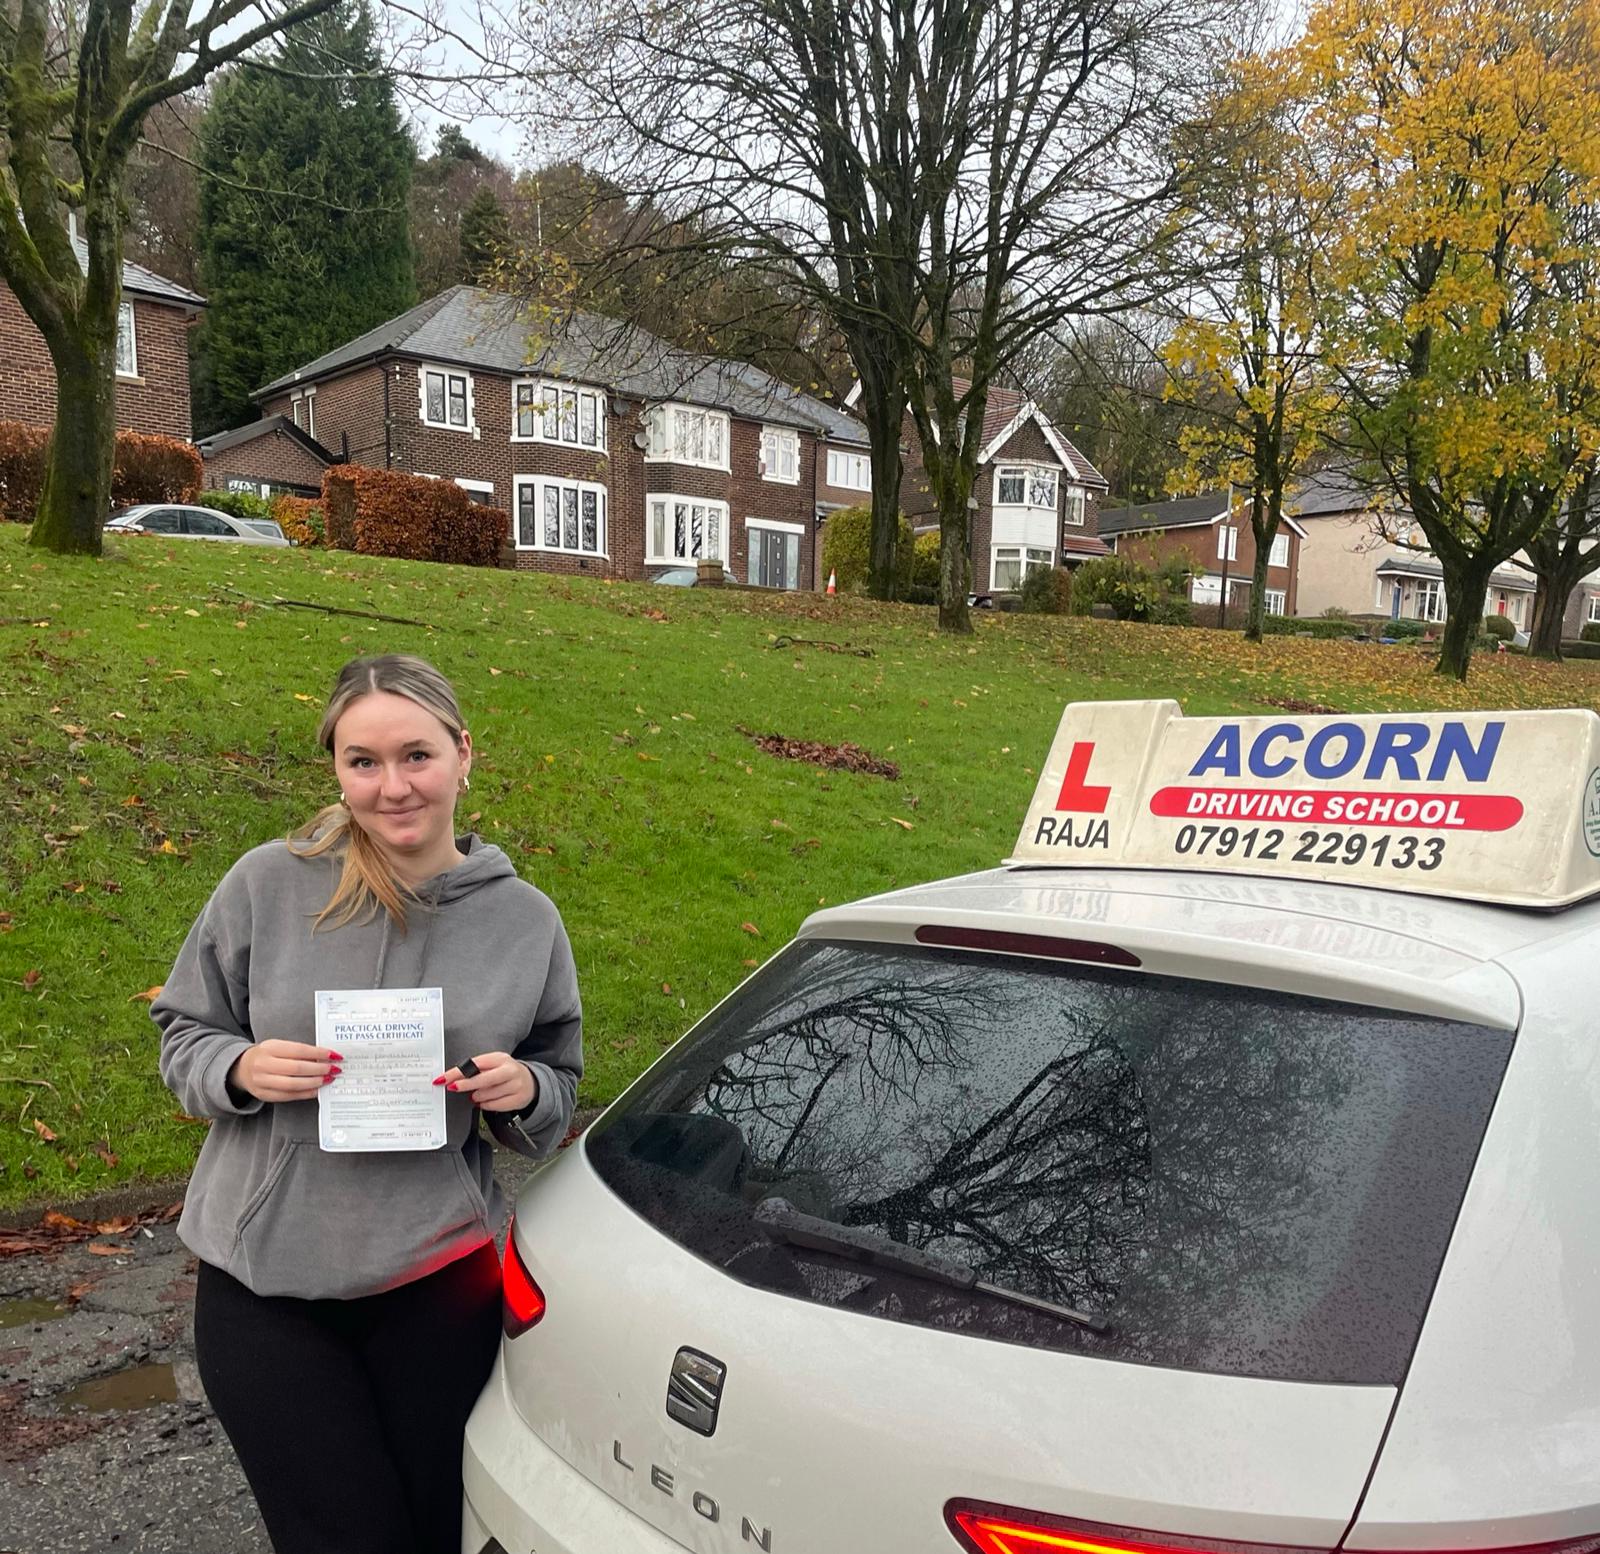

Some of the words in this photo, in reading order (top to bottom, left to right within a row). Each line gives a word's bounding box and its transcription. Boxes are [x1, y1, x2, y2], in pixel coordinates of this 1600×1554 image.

[1189, 722, 1505, 782] ACORN
[1055, 742, 1111, 813] L
[1186, 792, 1314, 818] DRIVING
[1323, 796, 1465, 825] SCHOOL
[1034, 817, 1109, 849] RAJA
[1175, 824, 1284, 860] 07912
[1291, 831, 1445, 871] 229133
[335, 1024, 382, 1033] PRACTICAL
[385, 1023, 424, 1032] DRIVING
[355, 1032, 374, 1040] PASS
[613, 1439, 772, 1554] LEON
